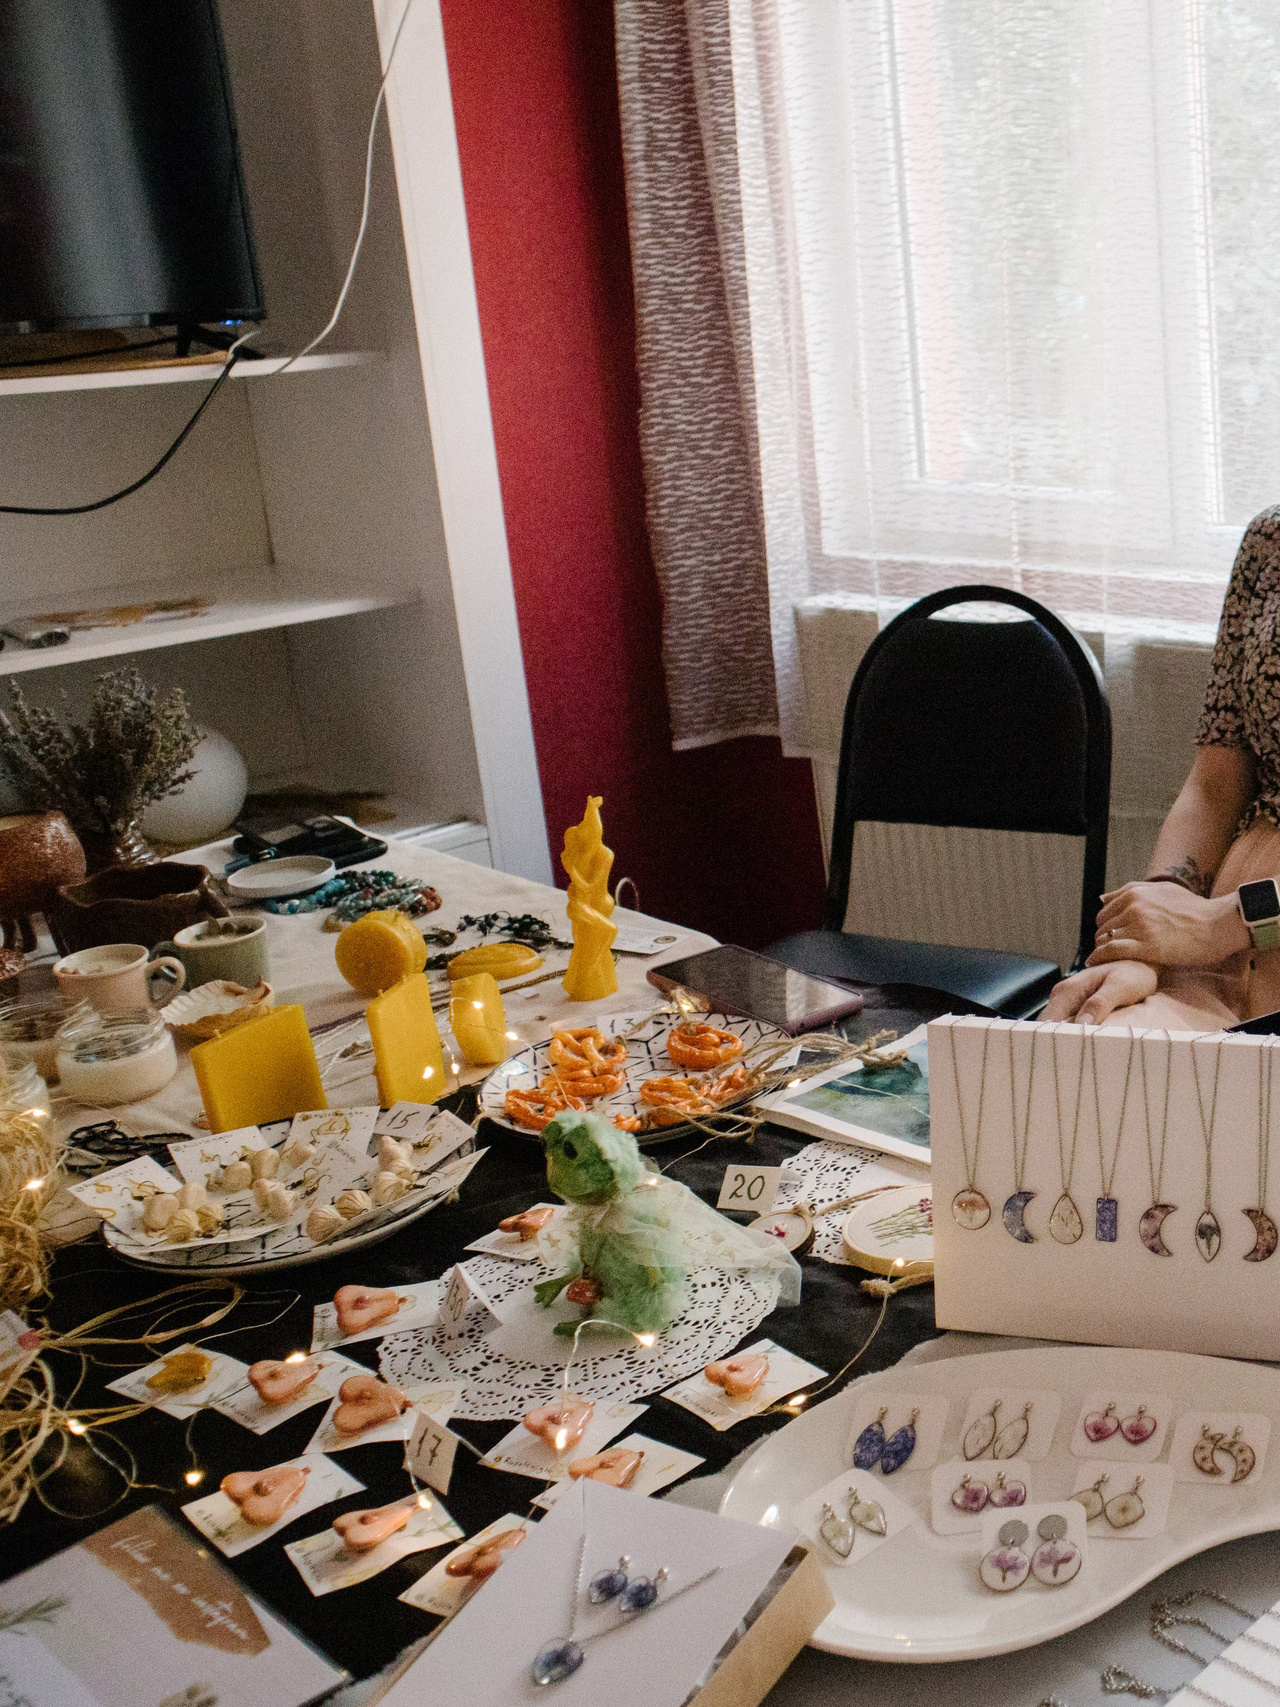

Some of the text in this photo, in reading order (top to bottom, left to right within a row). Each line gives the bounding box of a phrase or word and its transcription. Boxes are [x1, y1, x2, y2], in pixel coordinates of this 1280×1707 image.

[386, 1110, 421, 1130] 15
[728, 1172, 766, 1201] 20
[415, 1427, 443, 1467] 17
